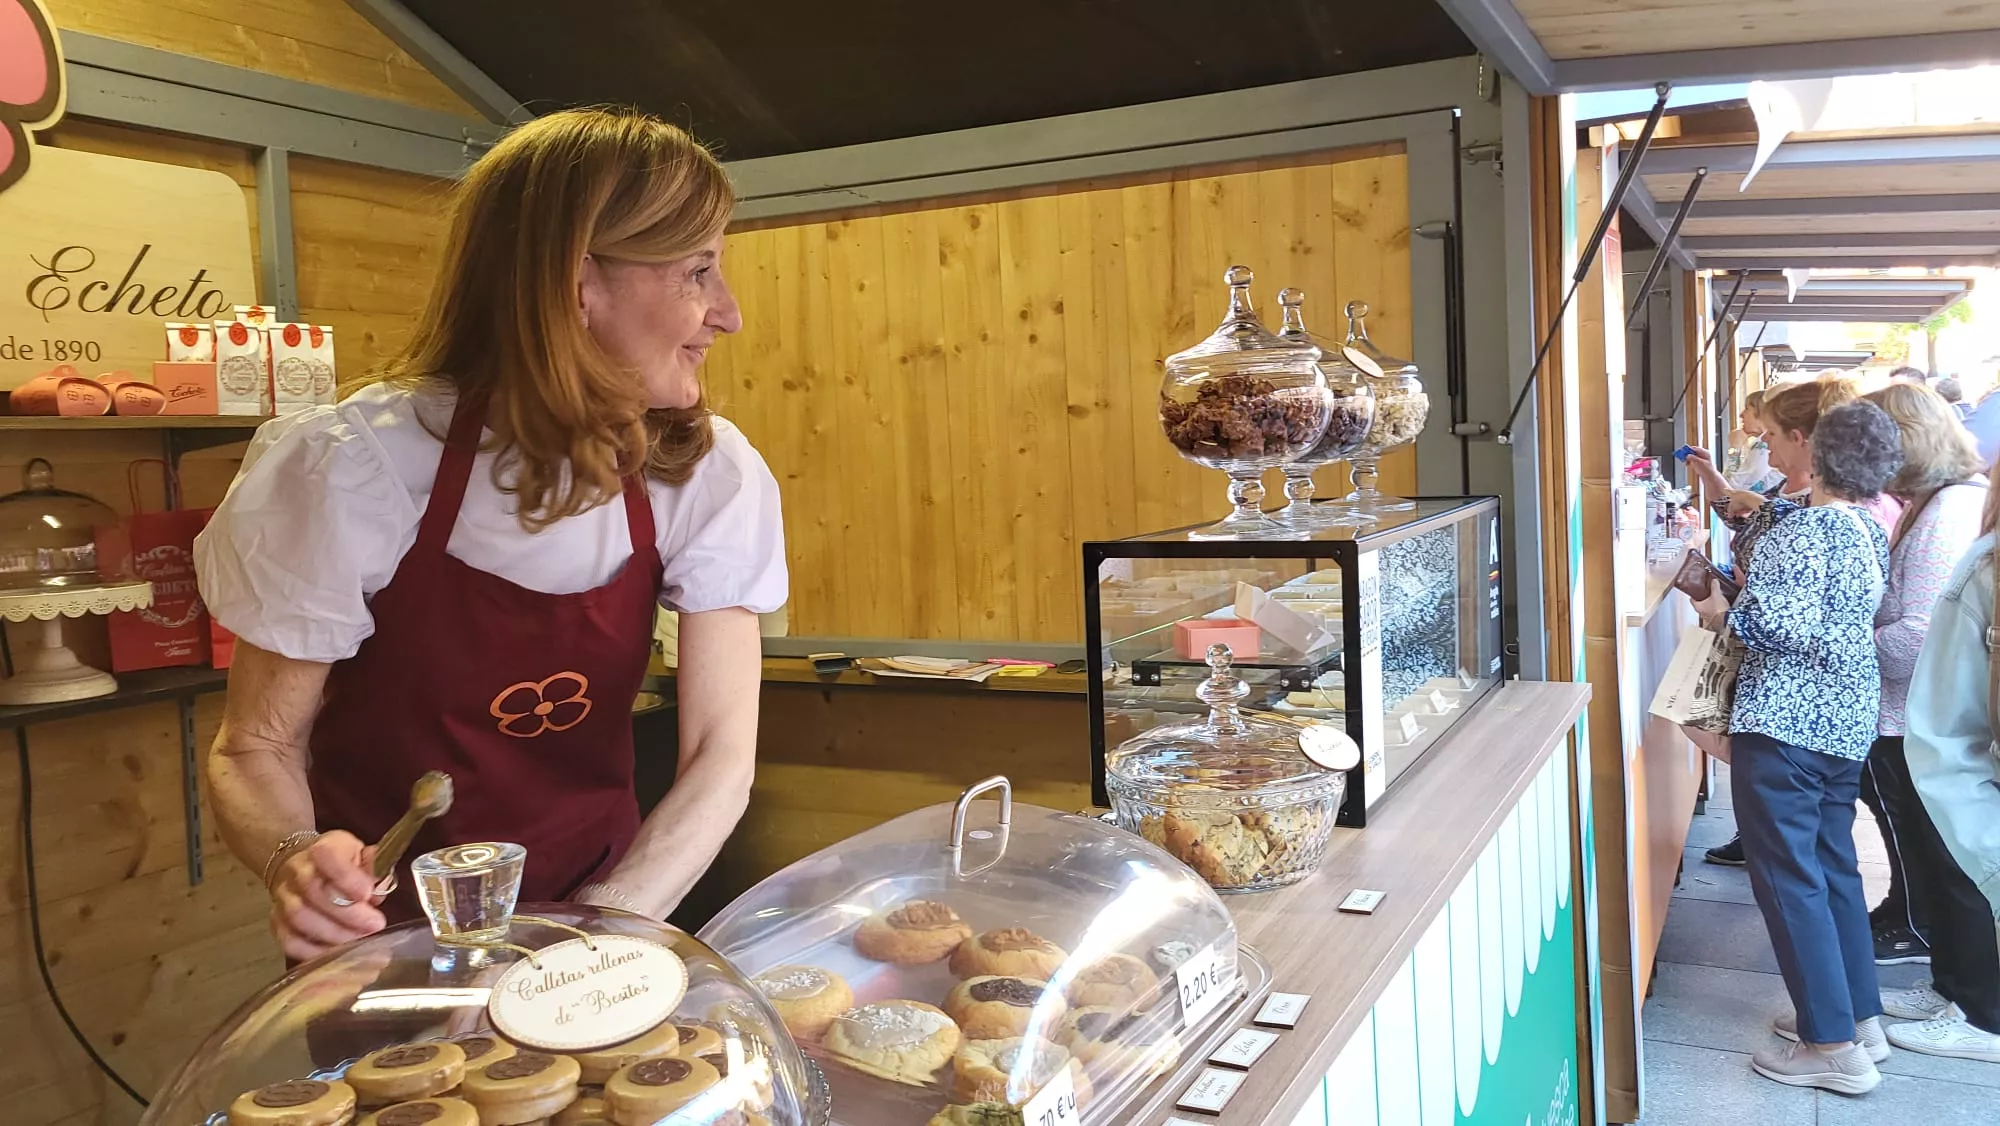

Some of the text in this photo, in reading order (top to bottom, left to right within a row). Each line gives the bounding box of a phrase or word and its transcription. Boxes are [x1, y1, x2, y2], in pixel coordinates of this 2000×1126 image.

[26, 243, 232, 323] Echeto
[0, 335, 101, 363] de 1890
[588, 949, 644, 974] rellenas
[554, 1006, 574, 1026] de
